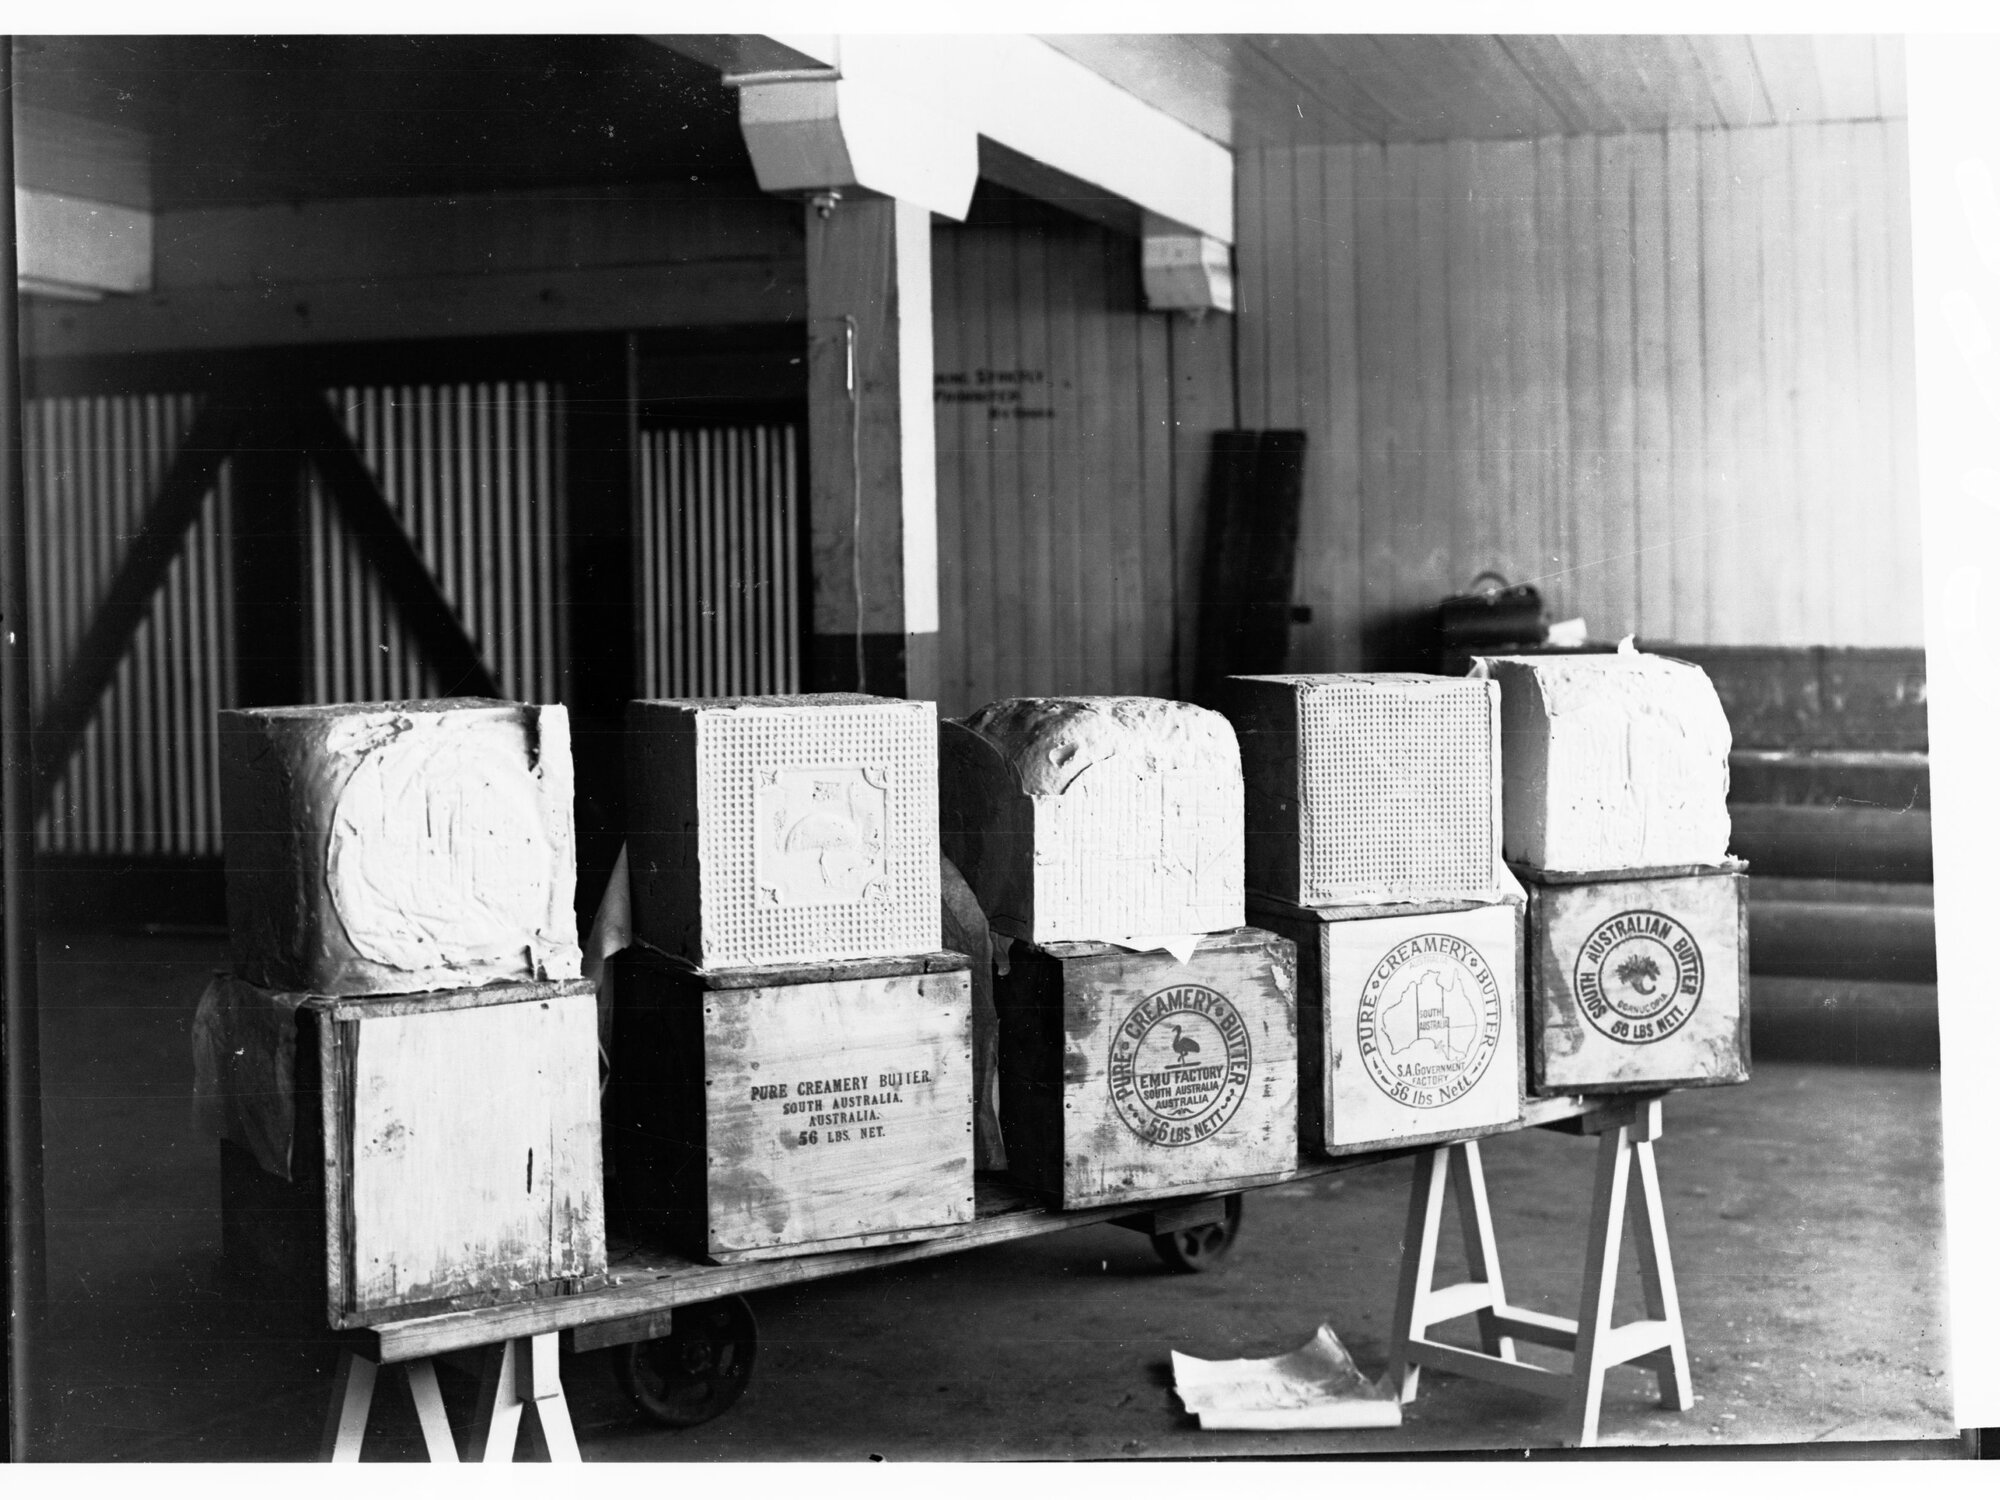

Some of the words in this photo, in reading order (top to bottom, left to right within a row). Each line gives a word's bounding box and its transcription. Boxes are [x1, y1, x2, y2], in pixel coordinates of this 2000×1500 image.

[1586, 916, 1672, 964] AUSTRALIAN
[1673, 937, 1698, 995] BUTTER
[1360, 994, 1377, 1057] PURE
[1378, 937, 1473, 980] CREAMERY
[1476, 968, 1498, 1048] BUTTER
[1580, 972, 1607, 1019] SOUTH
[1419, 1008, 1442, 1018] SOUTH
[1419, 1020, 1449, 1031] AUSTRALIA
[1633, 1023, 1654, 1039] LBS
[1112, 1052, 1135, 1101] PURE
[1124, 988, 1221, 1040] CREAMERY
[1220, 1012, 1248, 1086] BUTTER
[751, 1084, 788, 1101] PURE
[797, 1076, 868, 1096] CREAMERY
[1140, 1072, 1170, 1089] EMU
[1175, 1065, 1224, 1084] FACTORY
[1412, 1075, 1448, 1086] FACTORY
[1143, 1087, 1171, 1100] SOUTH
[1176, 1081, 1219, 1097] AUSTRALIA
[1155, 1094, 1209, 1110] AUSTRALIA
[1391, 1082, 1410, 1101] 56
[1413, 1091, 1433, 1105] lbs
[1439, 1076, 1472, 1103] Nett
[783, 1100, 822, 1115] SOUTH
[832, 1092, 903, 1110] AUSTRALIA.
[809, 1110, 880, 1127] AUSTRALIA.
[1146, 1117, 1170, 1141] 56
[1170, 1126, 1192, 1143] LBS
[1194, 1108, 1224, 1138] NETT
[798, 1130, 818, 1146] 56
[860, 1126, 885, 1139] NET.
